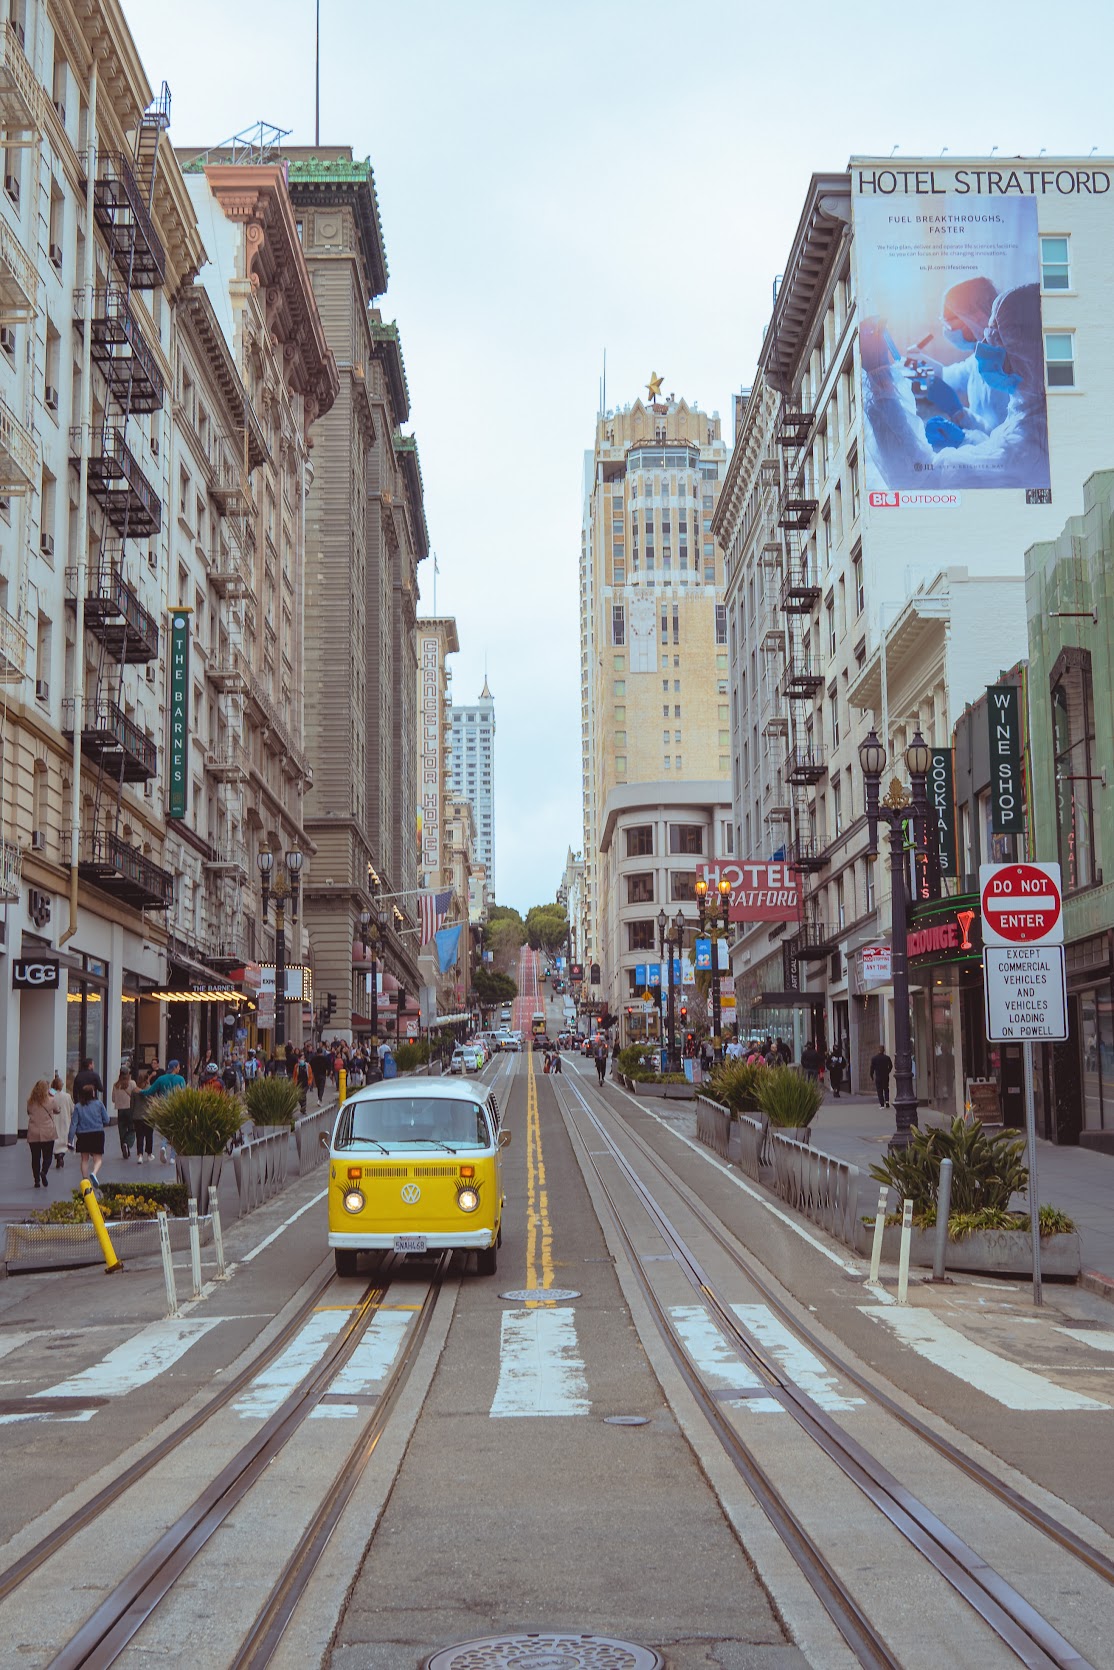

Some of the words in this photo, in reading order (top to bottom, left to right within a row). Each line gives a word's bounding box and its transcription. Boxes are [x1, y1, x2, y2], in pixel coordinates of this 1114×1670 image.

[858, 170, 946, 194] HOTEL
[954, 170, 1111, 195] STRATFORD
[888, 215, 912, 223] FUEL
[915, 215, 1005, 223] BREAKTHROUGHS,
[929, 226, 965, 234] FASTER
[901, 494, 957, 504] OUTDOOR
[175, 639, 184, 680] THE
[423, 639, 438, 784] CHANCELLOR
[994, 694, 1011, 755] WINE
[174, 691, 183, 782] BARNES
[998, 763, 1014, 825] SHOP
[932, 755, 949, 869] COCKTAILS
[423, 793, 438, 867] HOTEL
[703, 864, 797, 888] HOTEL
[993, 880, 1012, 893] DO
[1020, 879, 1048, 892] NOT
[704, 890, 798, 907] STRATFORD
[1000, 914, 1044, 928] ENTER
[1006, 949, 1041, 959] EXCEPT
[998, 961, 1051, 972] COMMERCIAL
[15, 964, 56, 985] UGG
[1003, 974, 1047, 985] VEHICLES
[1017, 988, 1035, 997] AND
[1005, 1000, 1048, 1010] VEHICLES
[1009, 1013, 1045, 1024] LOADING
[1002, 1026, 1014, 1036] ON
[1020, 1025, 1053, 1036] POWELL
